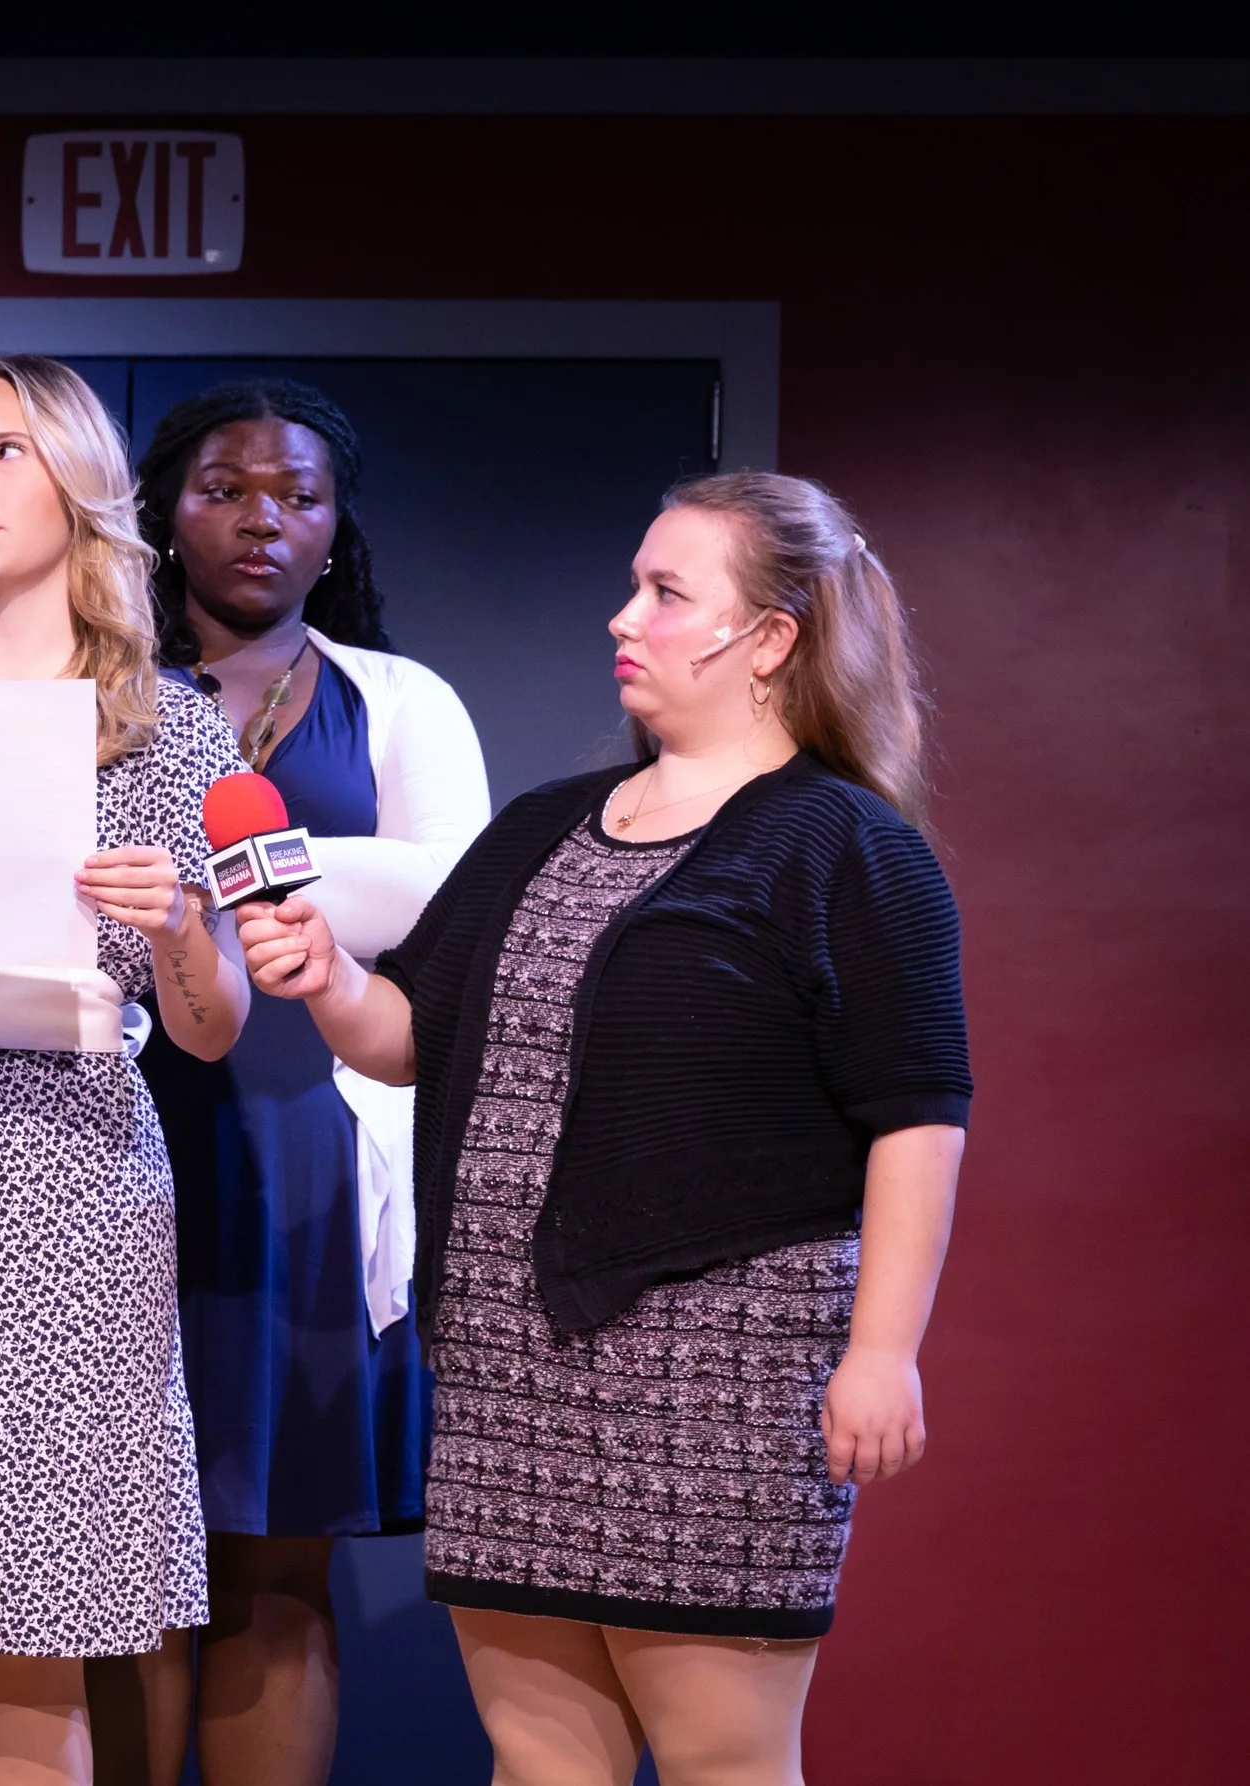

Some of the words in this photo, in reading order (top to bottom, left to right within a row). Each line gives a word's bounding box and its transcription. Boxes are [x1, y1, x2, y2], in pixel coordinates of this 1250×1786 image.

[62, 141, 216, 258] EXIT
[269, 846, 305, 860] BREAKING
[272, 855, 309, 870] INDIANA
[217, 860, 249, 881] BREAKING
[220, 869, 252, 890] INDIANA
